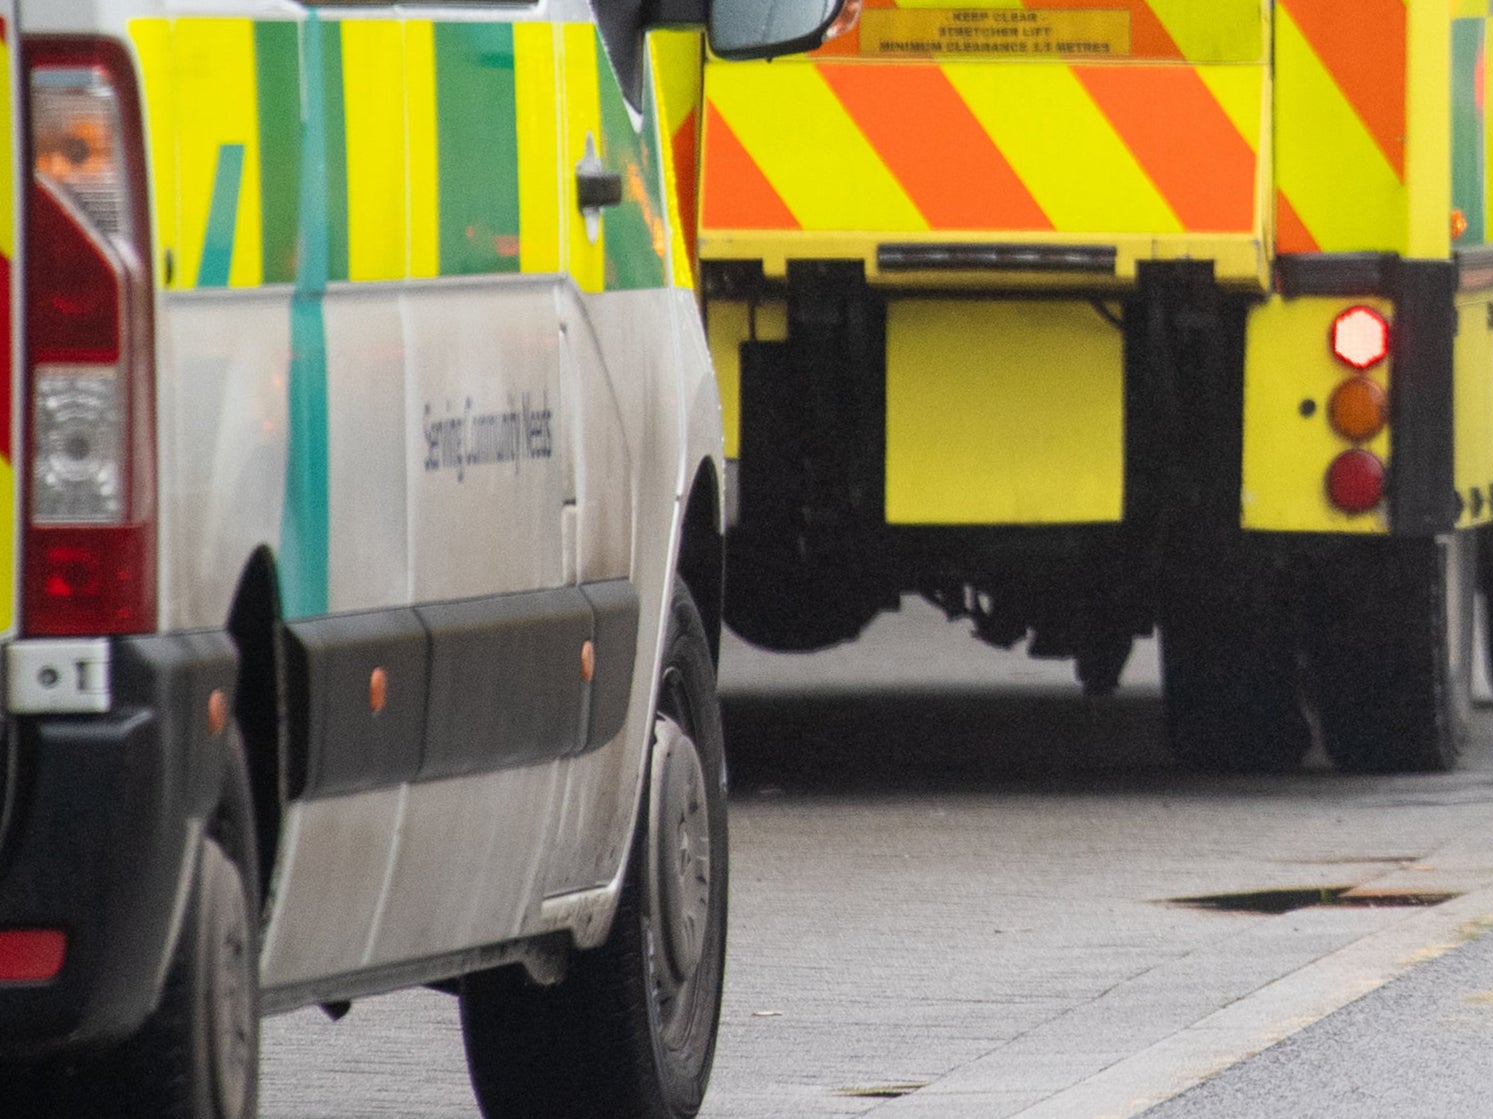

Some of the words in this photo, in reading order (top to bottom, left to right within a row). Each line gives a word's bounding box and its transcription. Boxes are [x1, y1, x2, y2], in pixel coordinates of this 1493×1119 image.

[952, 11, 989, 23] KEEP
[992, 11, 1038, 23] CLEAR
[938, 26, 1018, 38] STRETCHER
[1022, 26, 1052, 38] LIFT
[879, 41, 942, 54] MINIMUM
[945, 41, 1027, 54] CLEARANCE
[1056, 41, 1111, 54] METRES
